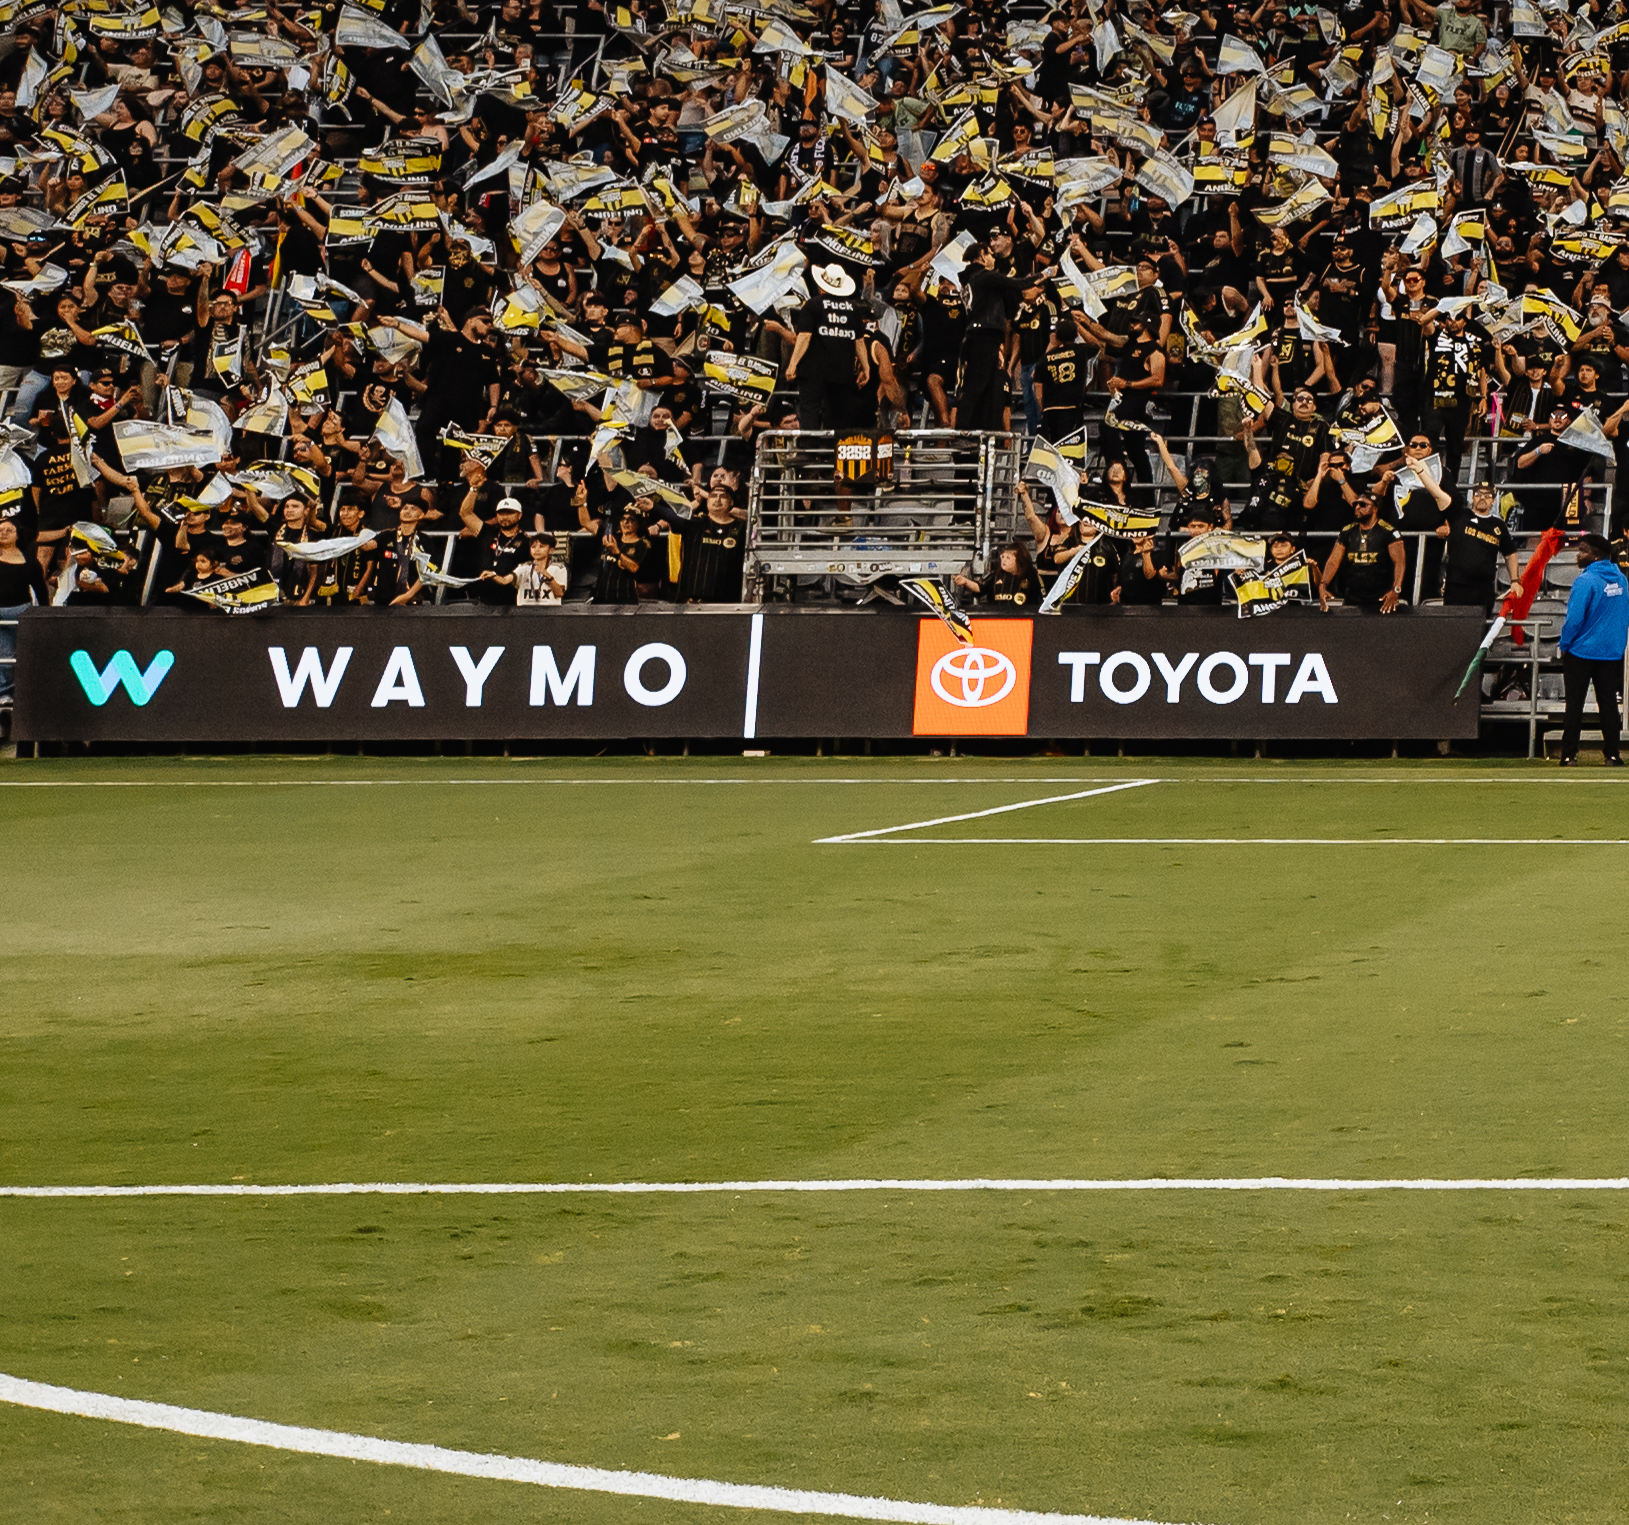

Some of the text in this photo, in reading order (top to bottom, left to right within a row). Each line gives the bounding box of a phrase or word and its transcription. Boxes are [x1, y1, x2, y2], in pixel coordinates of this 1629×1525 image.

[823, 300, 854, 312] Fuck
[828, 314, 848, 324] the
[1590, 342, 1610, 353] LEX
[1047, 350, 1075, 363] TORRES
[837, 444, 872, 461] 3252
[49, 454, 72, 464] ANT
[1082, 516, 1148, 539] ANGELINO
[1348, 552, 1378, 564] FLEX
[268, 642, 687, 708] WAYMO
[1058, 650, 1339, 705] TOYOTA
